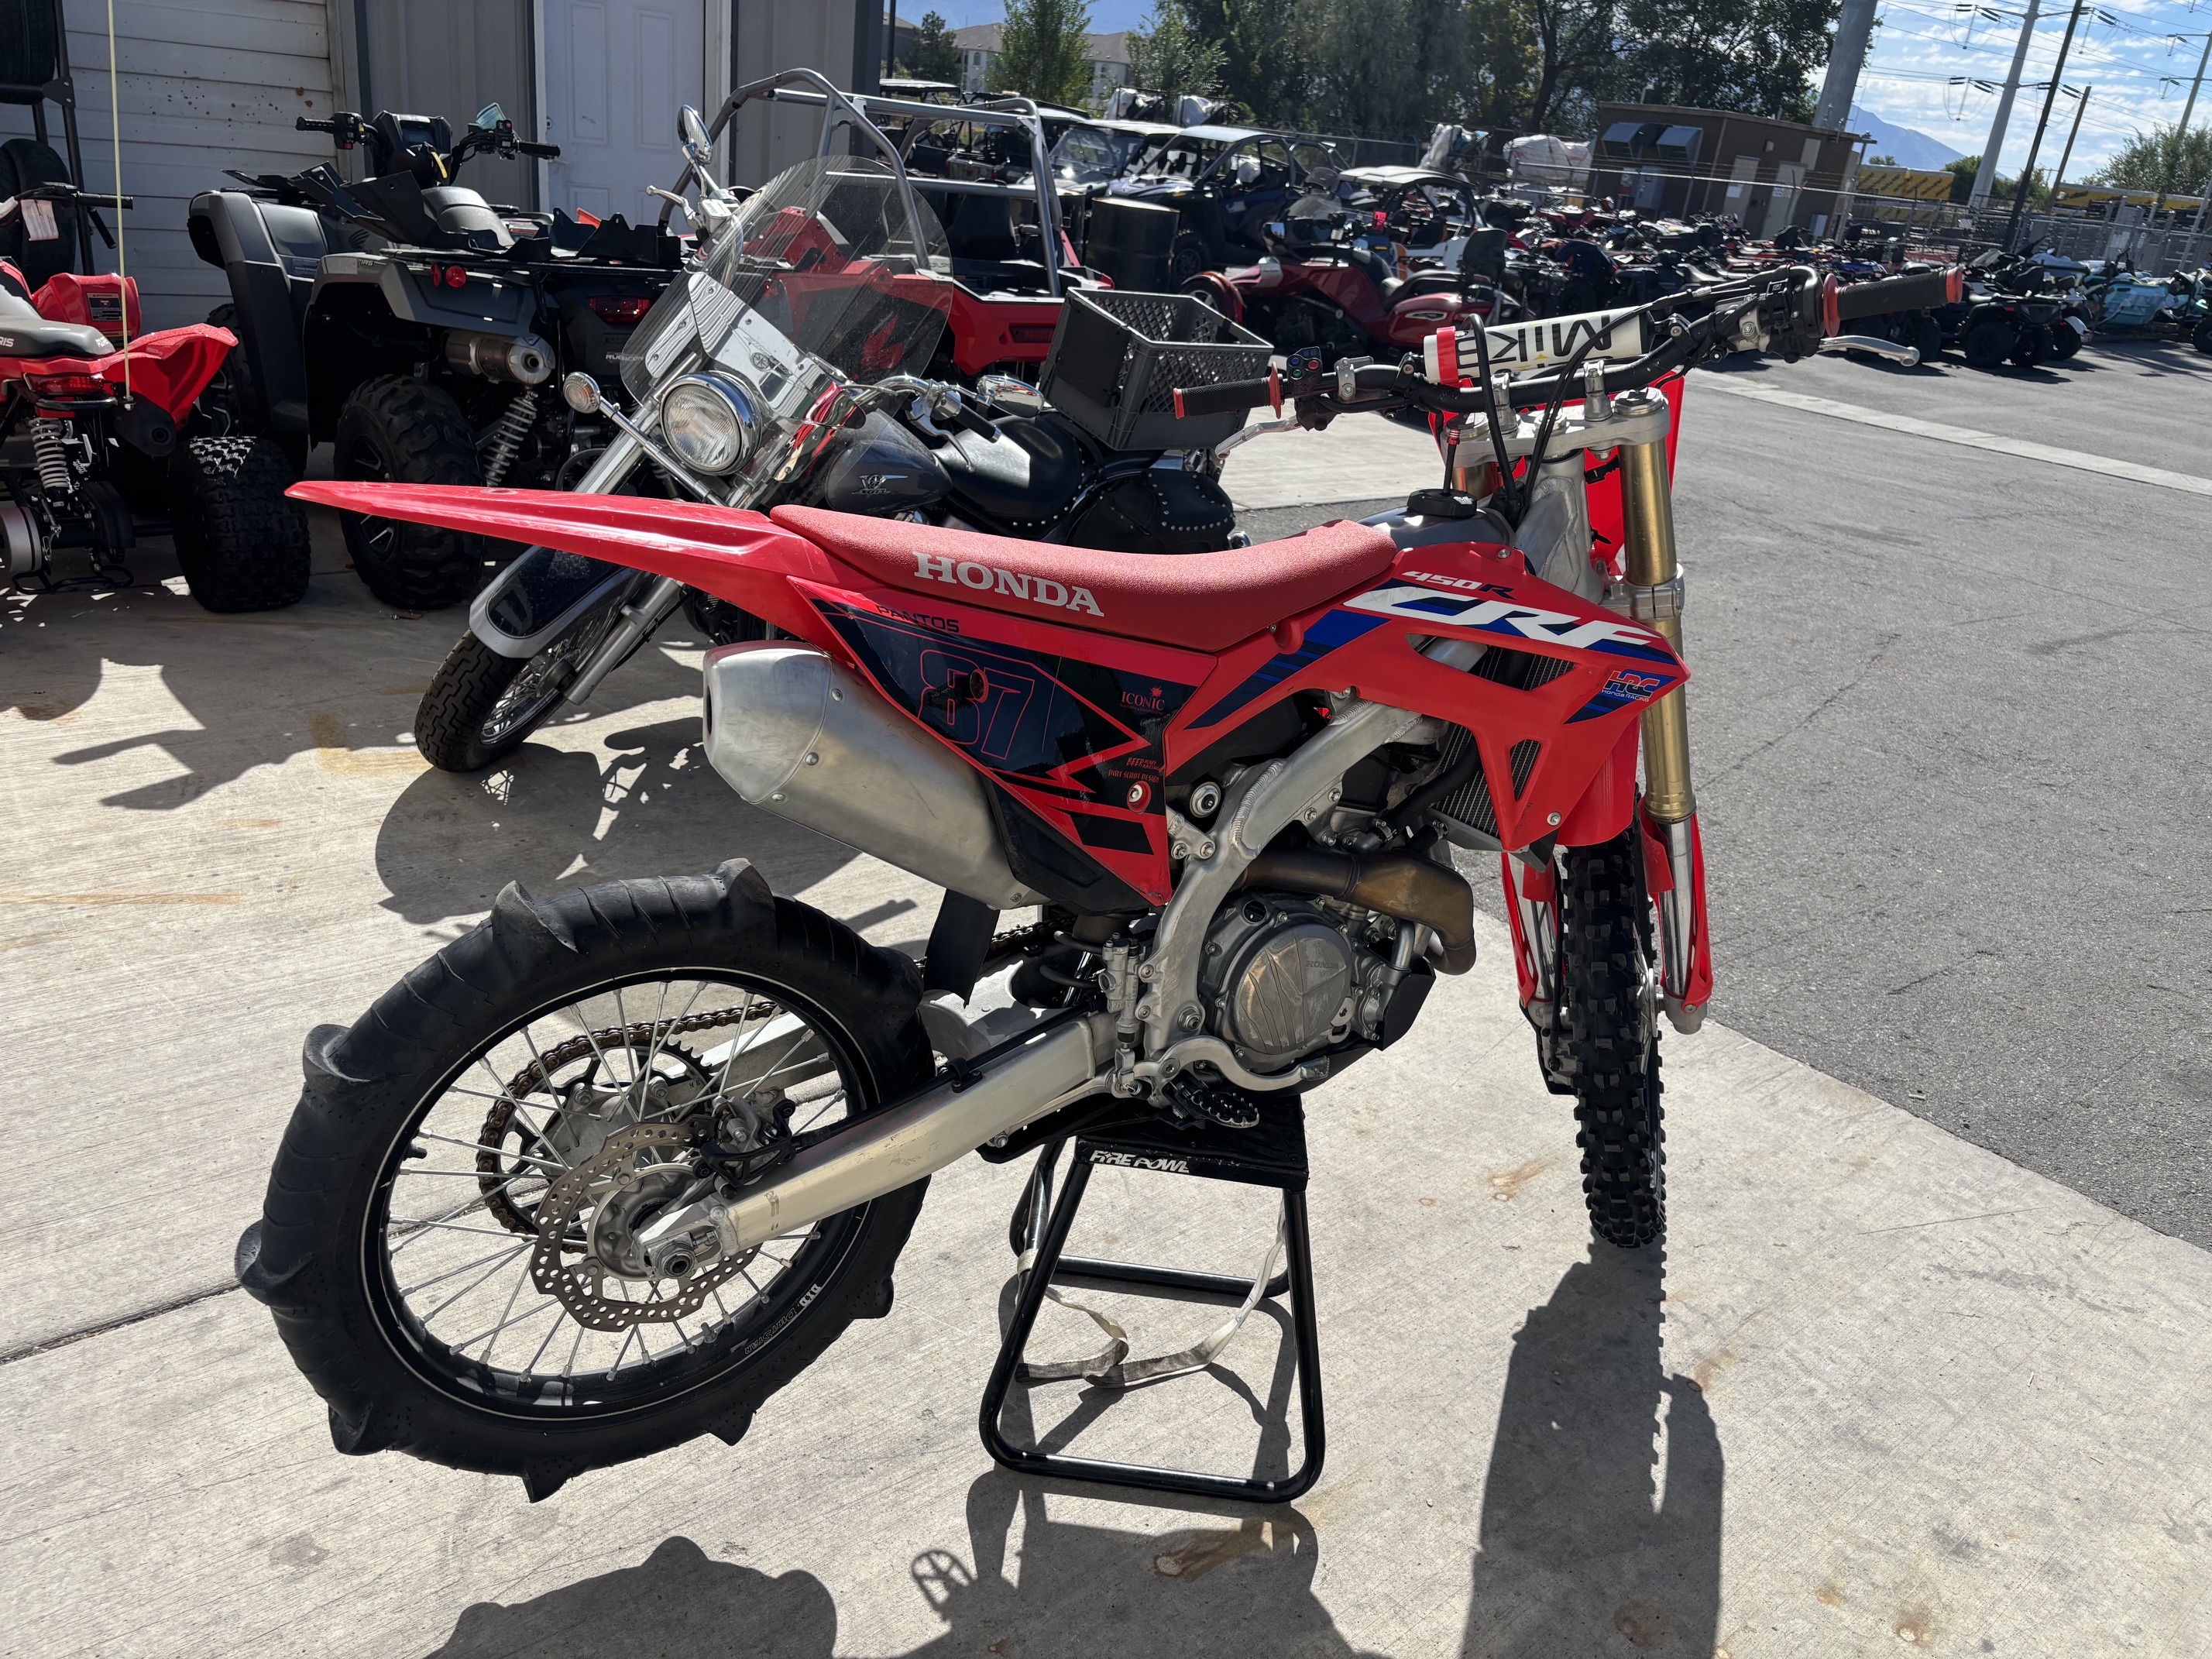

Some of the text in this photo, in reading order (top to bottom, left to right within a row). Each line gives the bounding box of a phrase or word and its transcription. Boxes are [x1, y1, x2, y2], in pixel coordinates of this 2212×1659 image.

[912, 551, 1104, 617] HONDA
[1402, 571, 1517, 601] 450R
[1343, 586, 1661, 649] CRF
[1603, 670, 1661, 698] HRC
[918, 649, 1036, 761] 87
[1121, 691, 1165, 711] ICONIC
[1625, 693, 1650, 702] RACING
[1125, 757, 1145, 767] BEER
[1306, 960, 1341, 970] HONDA
[1135, 1157, 1190, 1173] POWE
